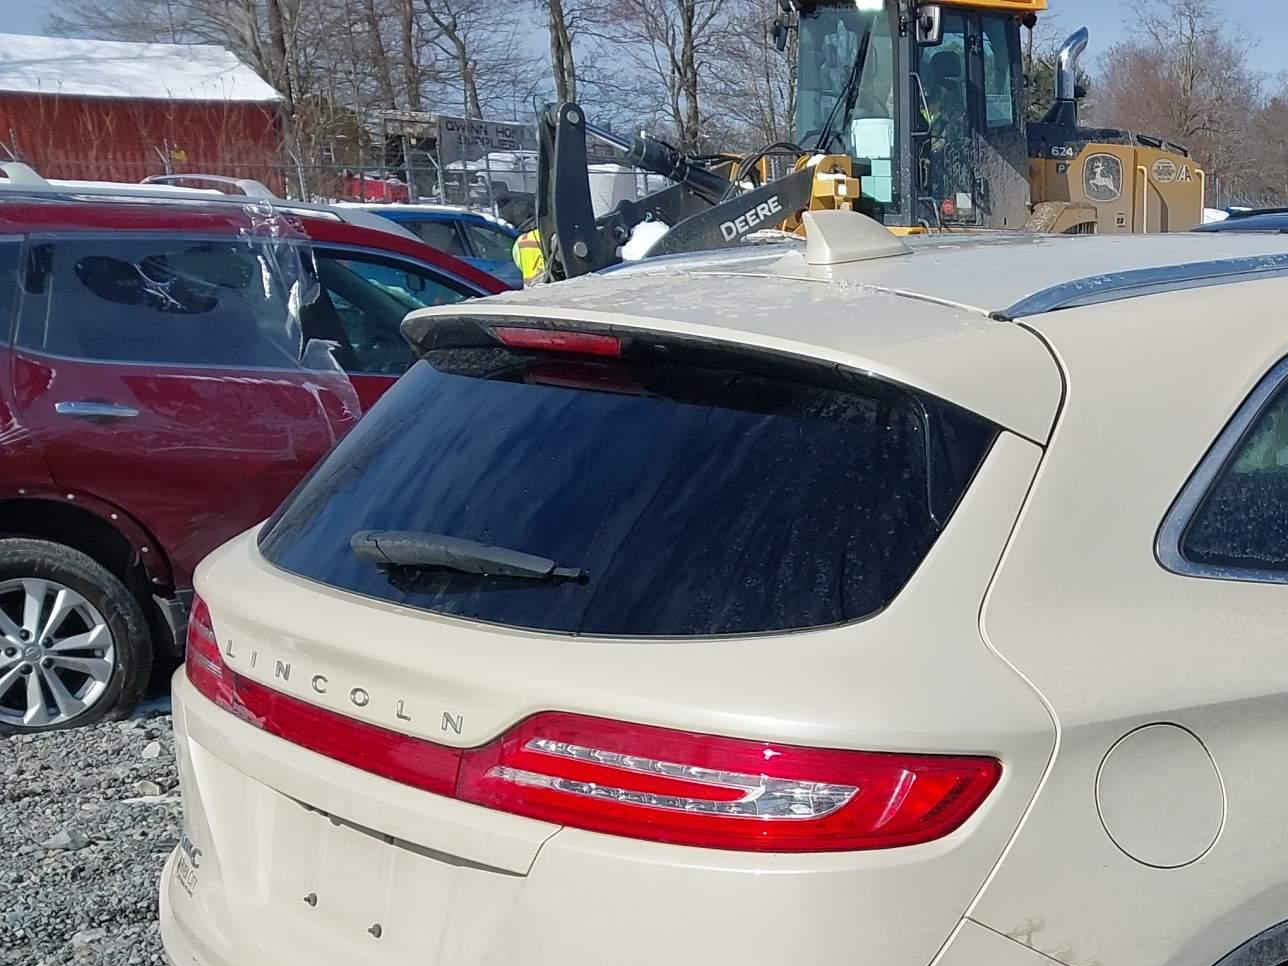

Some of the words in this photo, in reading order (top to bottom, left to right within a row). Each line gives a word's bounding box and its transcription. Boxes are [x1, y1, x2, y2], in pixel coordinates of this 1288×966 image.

[1051, 147, 1074, 157] 624
[720, 195, 783, 242] DEERE
[225, 639, 464, 735] LINCOLN
